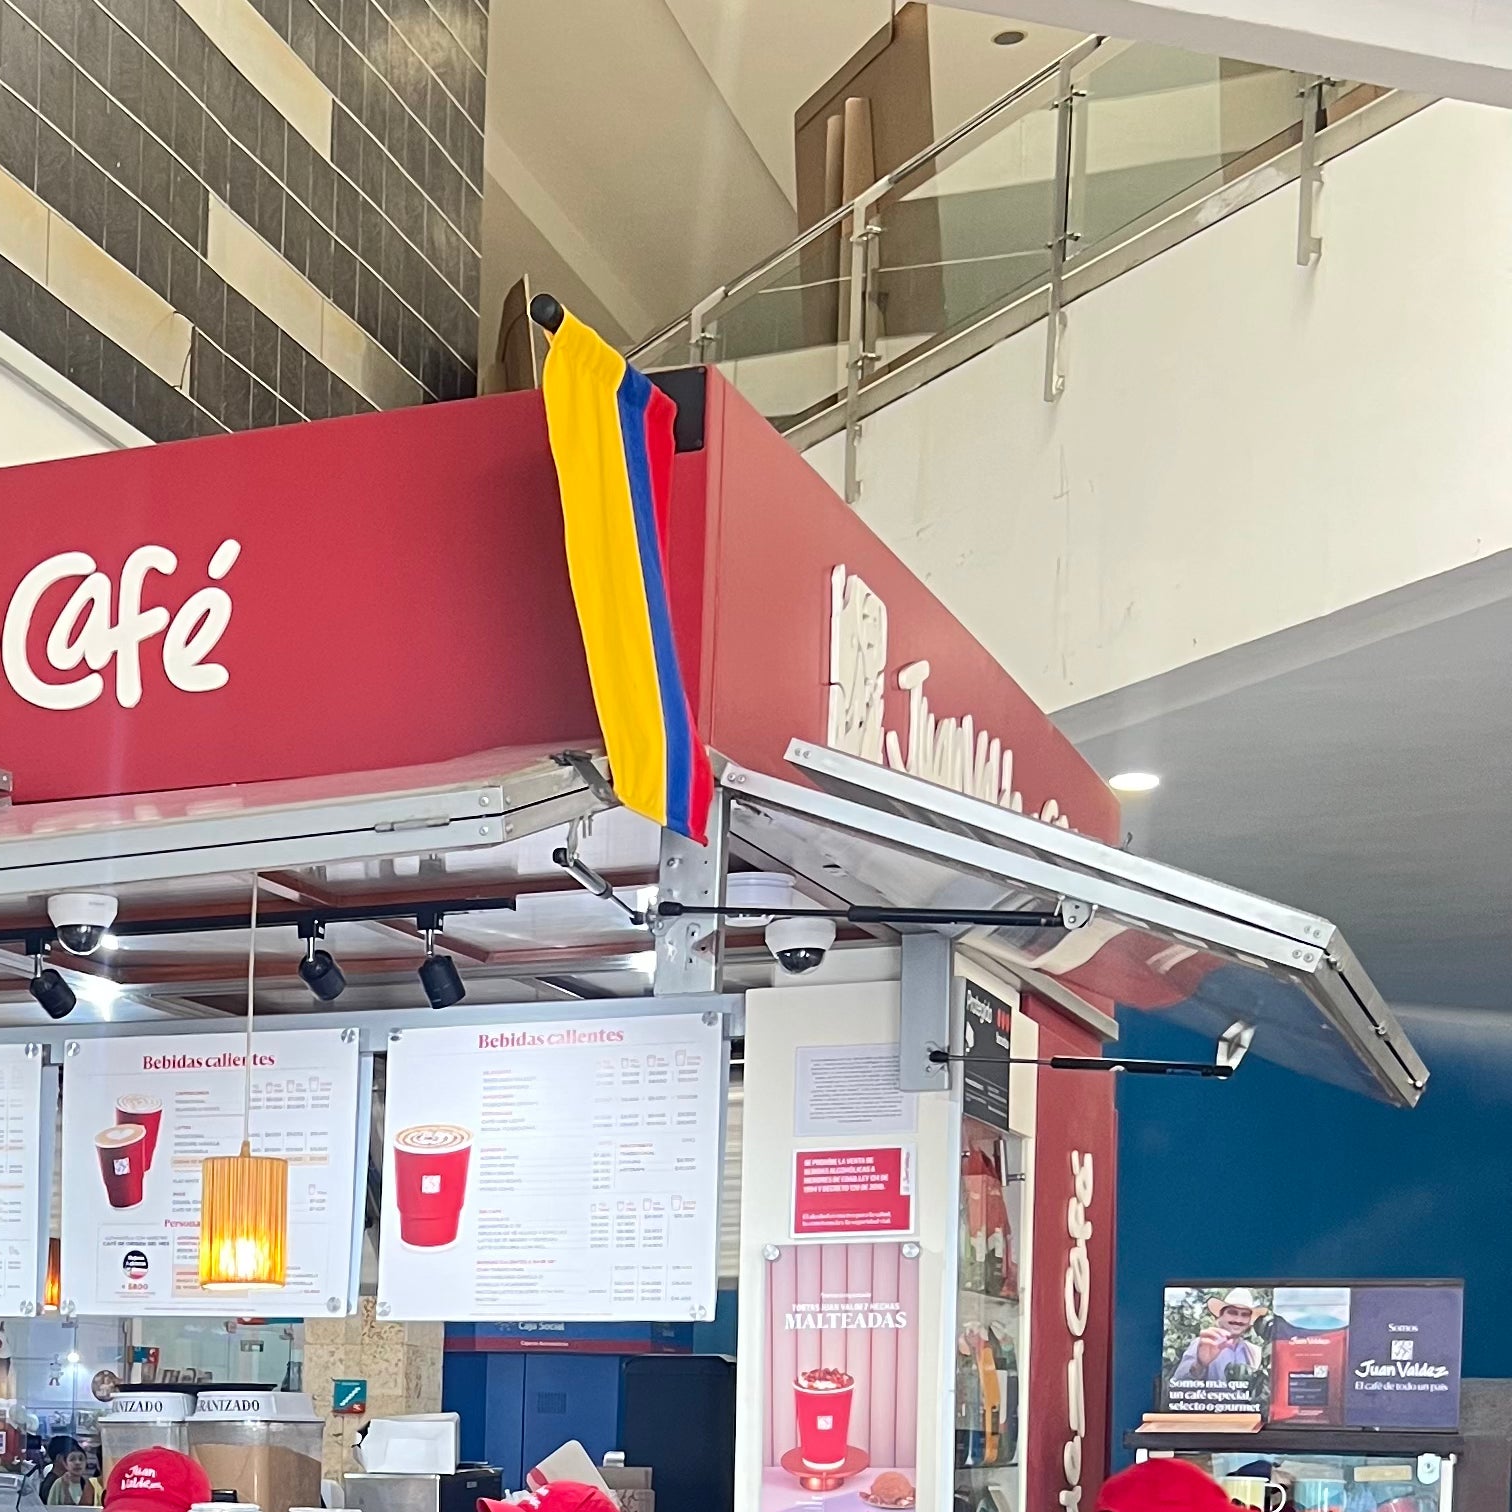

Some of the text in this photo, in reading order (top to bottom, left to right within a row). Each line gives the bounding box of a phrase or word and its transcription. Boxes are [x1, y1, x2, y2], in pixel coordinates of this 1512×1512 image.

[3, 540, 242, 710] Café
[478, 1029, 624, 1050] Bebidas calientes
[143, 1053, 203, 1072] Bebidas
[164, 1219, 201, 1228] Persona
[785, 1311, 907, 1330] MALTEADAS
[1388, 1323, 1419, 1333] Somos
[1354, 1359, 1449, 1379] Juan Valdez
[1169, 1378, 1205, 1388] Somos
[1228, 1380, 1249, 1390] que
[1169, 1391, 1184, 1399] un
[1184, 1389, 1206, 1400] café
[1169, 1401, 1206, 1411] selecto
[1214, 1402, 1260, 1413] gourmet
[125, 1465, 156, 1478] Juan
